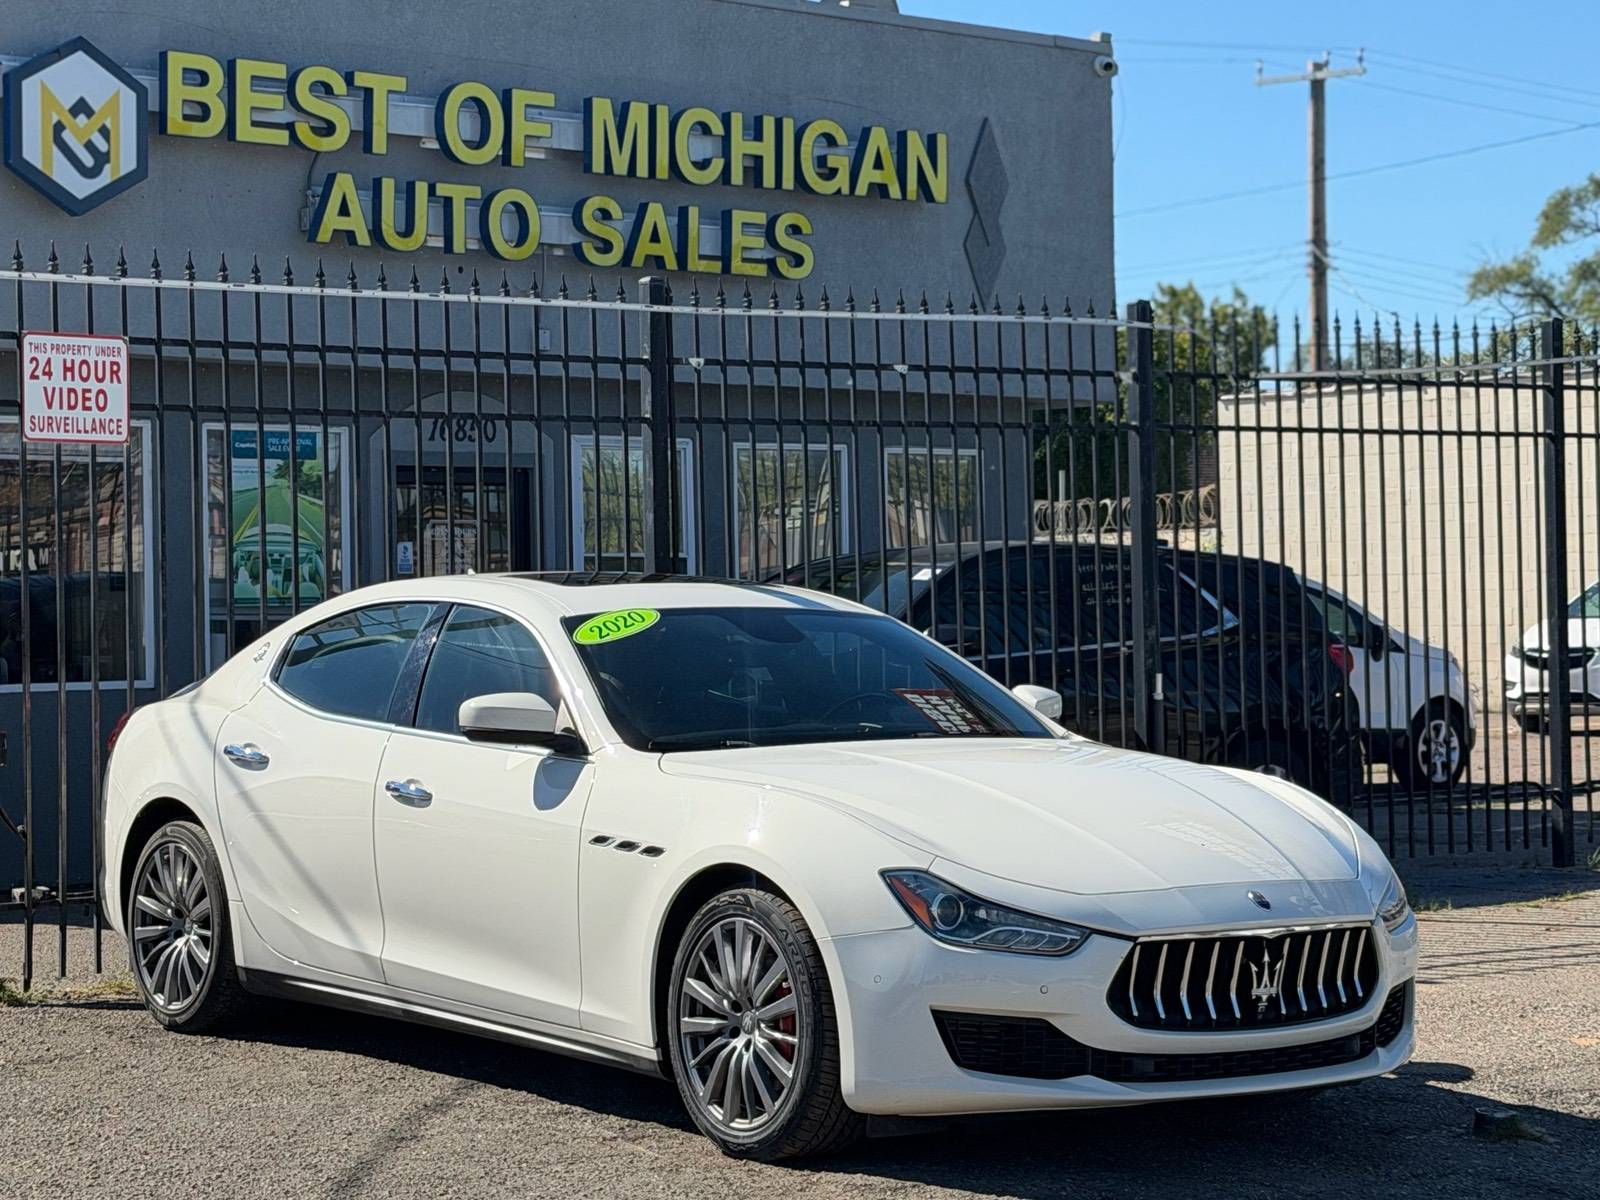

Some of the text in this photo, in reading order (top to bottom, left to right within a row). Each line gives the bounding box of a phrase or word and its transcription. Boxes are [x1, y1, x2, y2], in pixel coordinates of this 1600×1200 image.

[162, 50, 949, 204] BEST OF MICHIGAN
[310, 171, 816, 280] AUTO SALES
[28, 341, 122, 358] THIS PROPERTY UNDER
[29, 356, 122, 385] 24 HOUR
[42, 386, 109, 413] VIDEO
[29, 414, 123, 436] SURVEILLANCE
[589, 611, 646, 639] 2020
